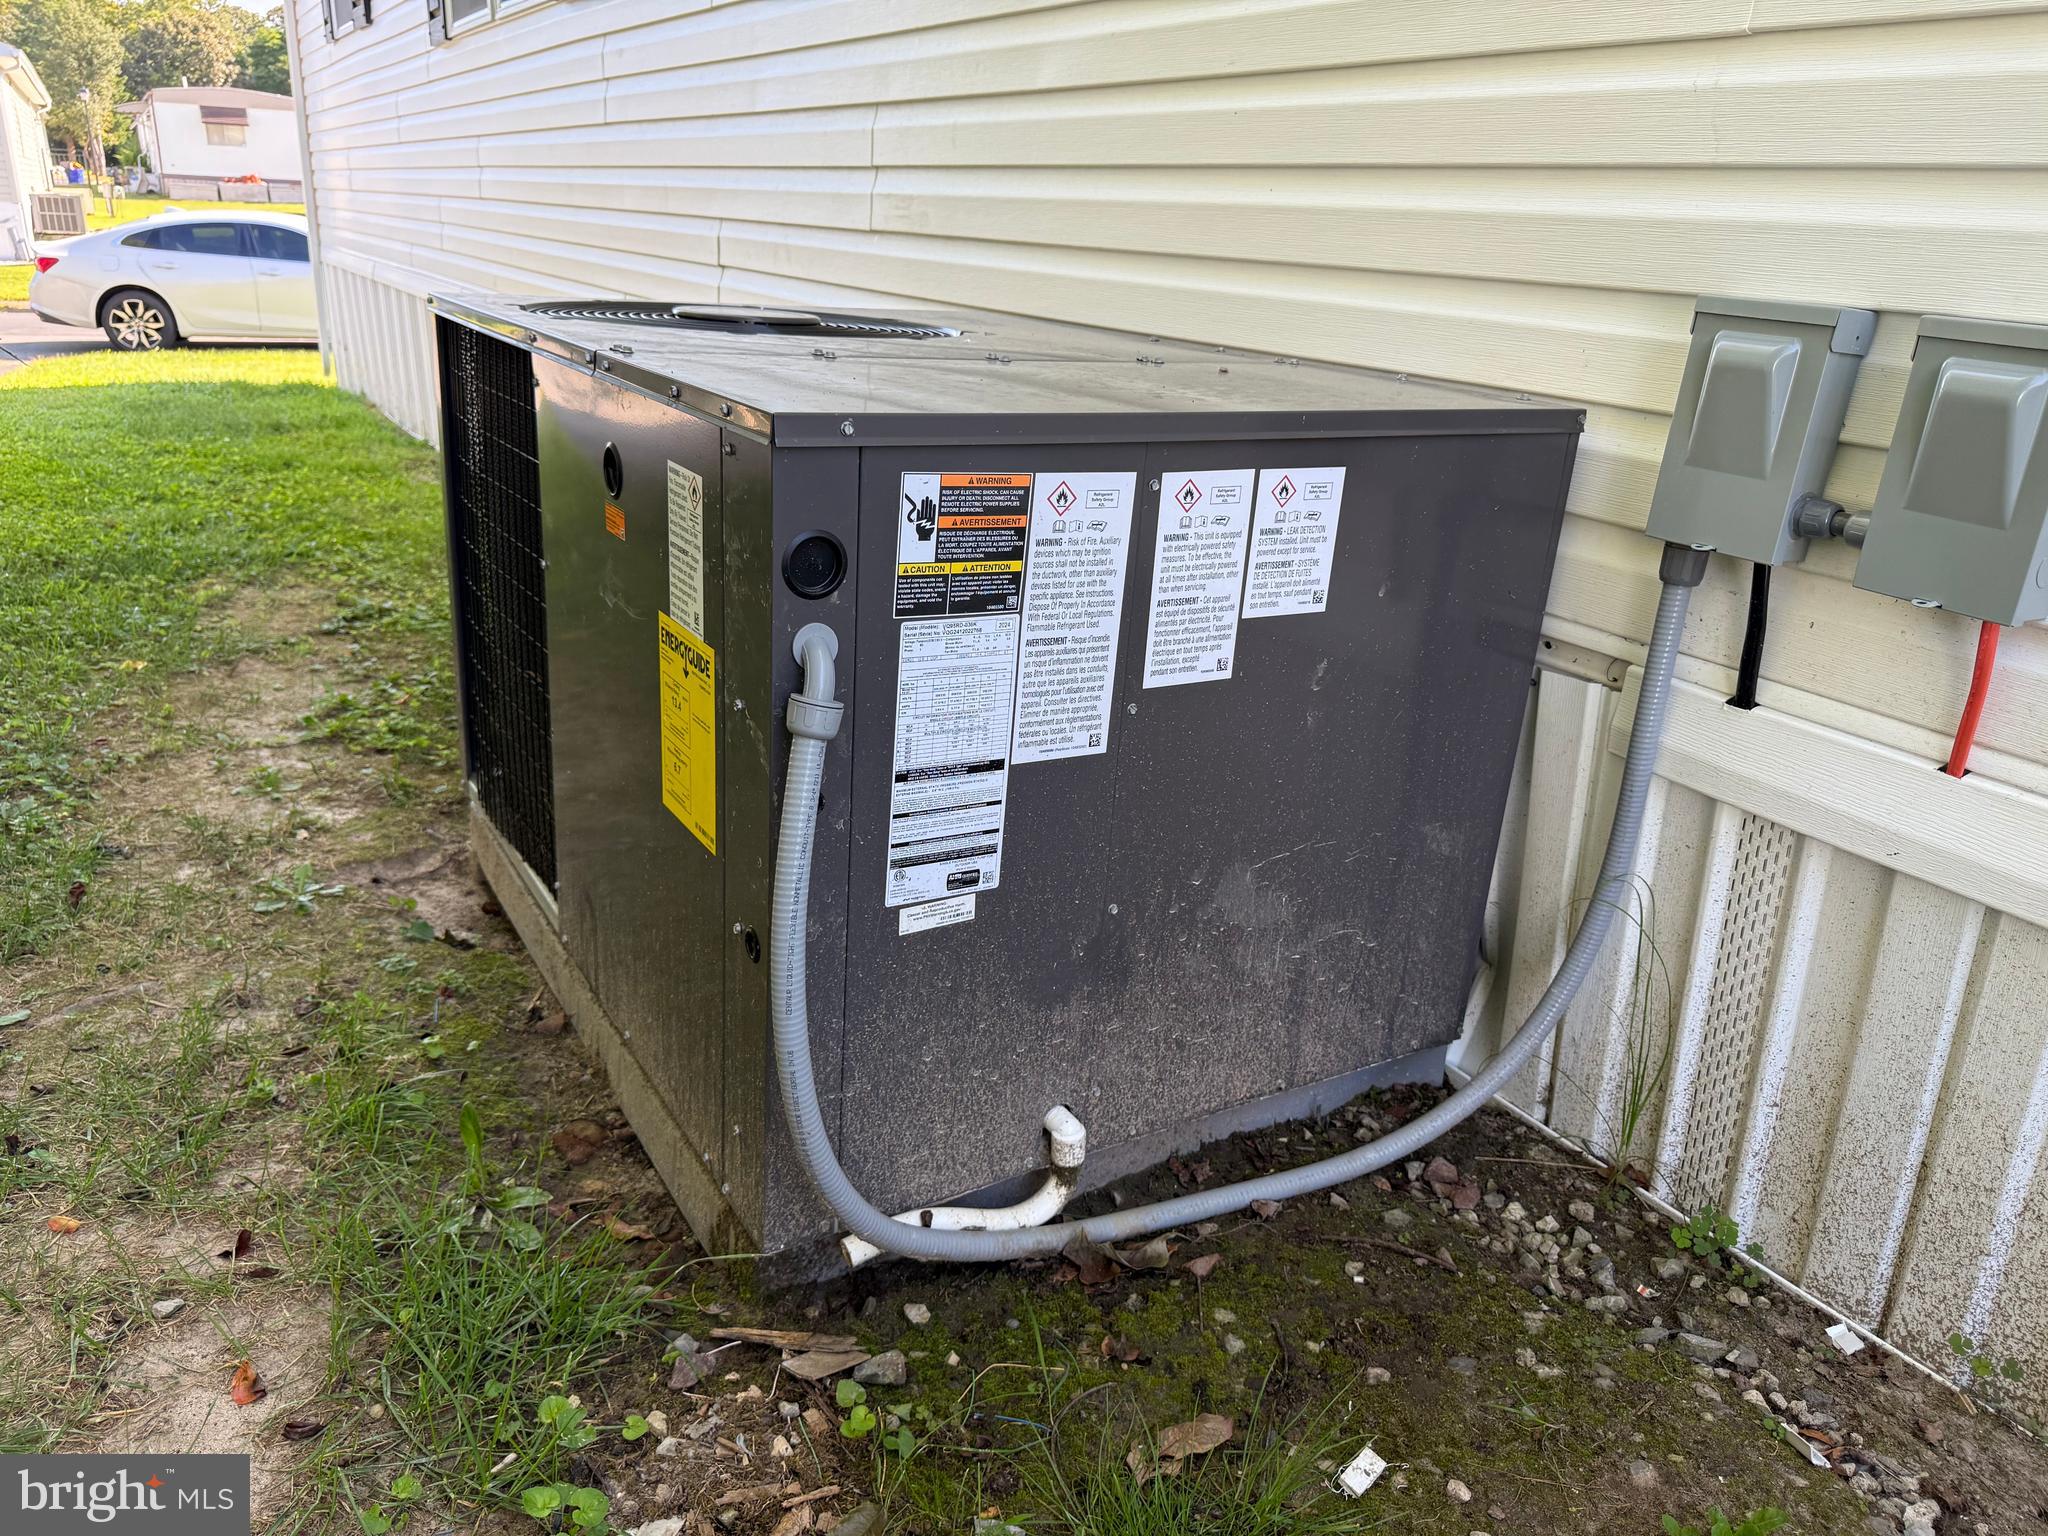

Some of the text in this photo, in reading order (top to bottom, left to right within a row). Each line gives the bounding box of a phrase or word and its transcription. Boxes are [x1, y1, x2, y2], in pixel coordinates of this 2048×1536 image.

[1164, 533, 1189, 542] WARNING
[1221, 530, 1242, 539] equipped
[1260, 525, 1326, 536] WARNING LEAK DETECTION
[1036, 538, 1062, 547] WARNING
[1099, 536, 1121, 546] Auxiliary
[1174, 543, 1199, 552] electrically
[1200, 542, 1220, 550] powered
[1222, 541, 1236, 550] safety
[1258, 538, 1278, 546] SYSTEM
[1034, 550, 1054, 558] devices
[1056, 549, 1071, 557] which
[1092, 548, 1111, 557] ignition
[1257, 548, 1276, 557] powered
[1192, 562, 1216, 571] electrically
[1217, 561, 1238, 569] powered
[1255, 560, 1294, 570] AVERTISSEMENT
[1096, 568, 1117, 577] auxiliary
[1030, 592, 1048, 601] specific
[1076, 590, 1084, 598] See
[1157, 596, 1200, 608] AVERTISSEMENT
[1212, 594, 1231, 603] appareil
[1029, 603, 1050, 612] Dispose
[1058, 601, 1080, 610] Properly
[1042, 612, 1060, 620] Federal
[1027, 624, 1055, 632] Flammable
[1057, 621, 1085, 631] Refrigerant
[1025, 636, 1087, 647] AVERTISSEMENT Risque
[661, 626, 710, 679] ENERGYGUIDE
[800, 814, 812, 860] CONDUIT-TYPE
[793, 864, 805, 906] NONMETALLIC
[789, 908, 798, 940] FLEXIBLE
[786, 941, 795, 986] LIQUID-TIGHT
